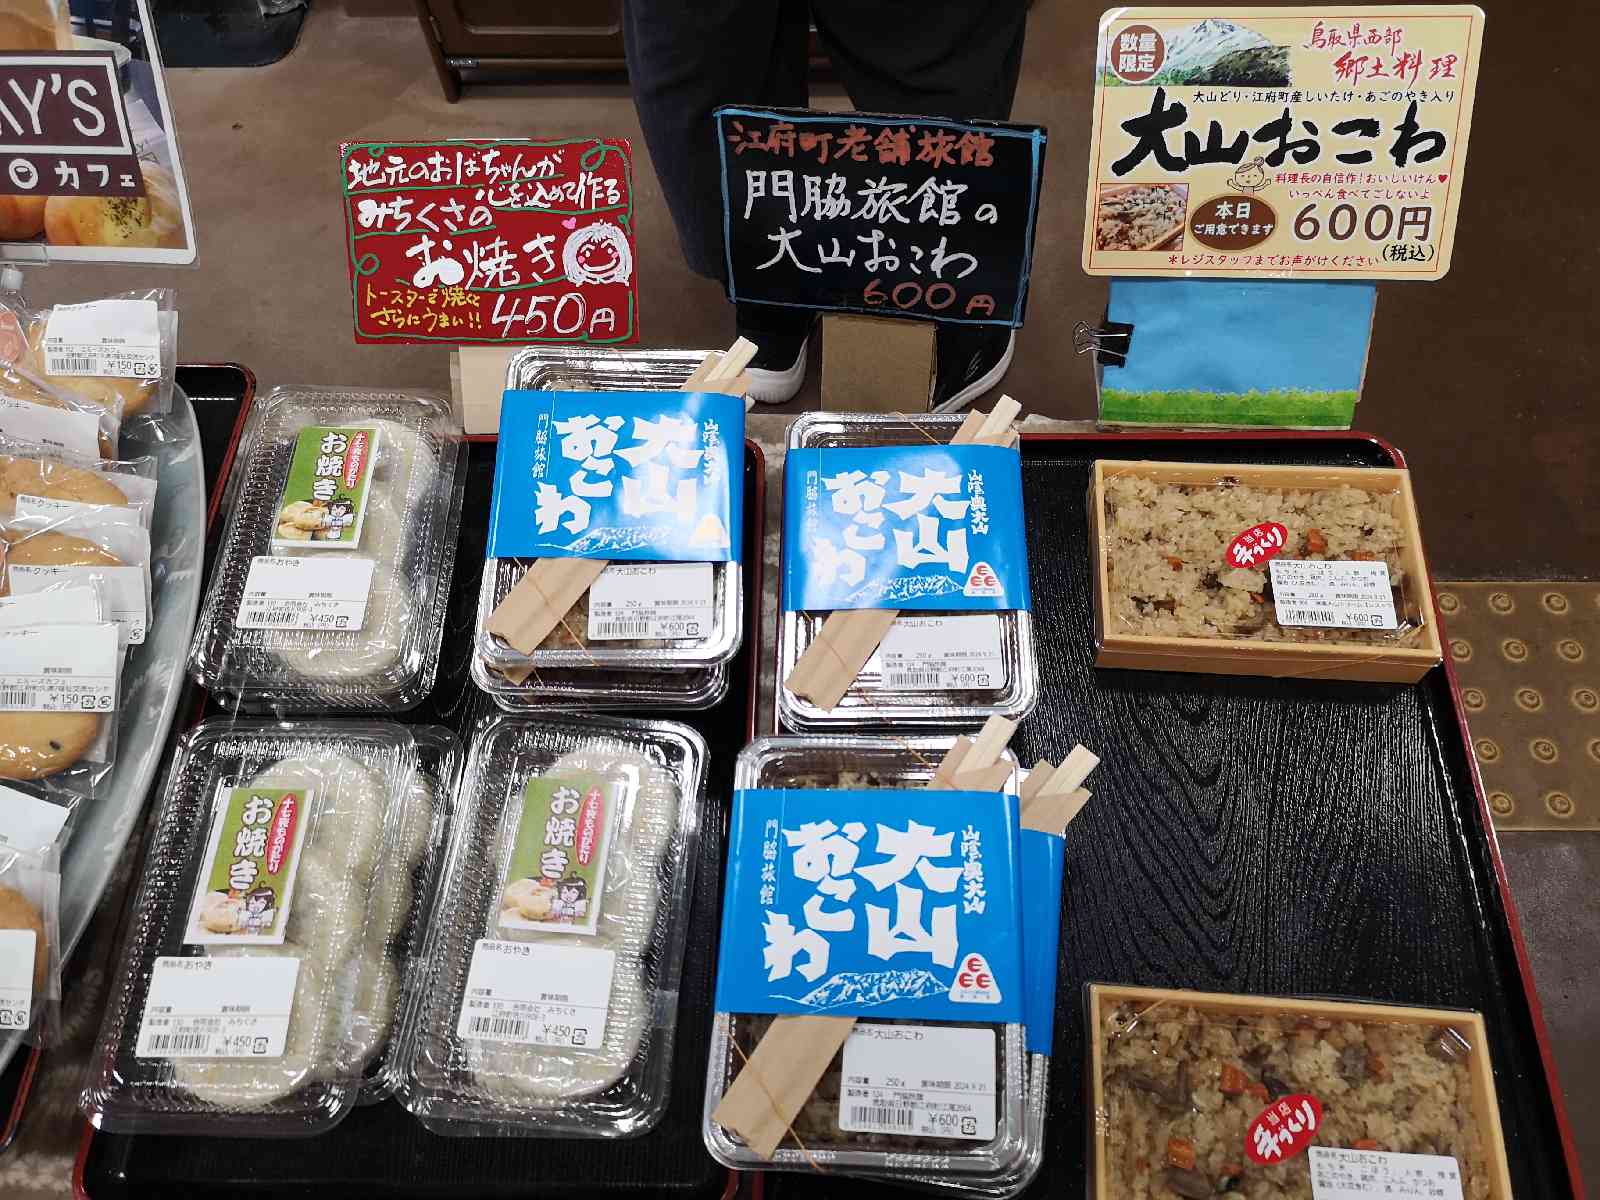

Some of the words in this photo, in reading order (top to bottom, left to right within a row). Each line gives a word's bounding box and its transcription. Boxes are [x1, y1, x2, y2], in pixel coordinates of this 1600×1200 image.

[1120, 33, 1157, 52] 数量
[1303, 21, 1402, 56] 鳥取県西部
[1119, 53, 1155, 72] 限定
[1333, 50, 1458, 89] 郷土料理
[727, 121, 996, 168] 江府町老舗旅館
[1111, 86, 1447, 177] 大山おこわ
[54, 160, 136, 190] カフェ
[347, 148, 566, 190] 地元のおばちゃんが
[475, 170, 621, 210] 心を込めて作る
[357, 196, 493, 232] みちくさの
[743, 169, 998, 226] 門脇旅館の
[1215, 201, 1251, 219] 本日
[1289, 189, 1430, 201] いっぺん食べてごしないよ
[1194, 223, 1274, 236] ご用意できます
[1294, 203, 1432, 242] 600円
[405, 233, 558, 290] お焼き
[755, 226, 979, 278] 大山おこわ
[366, 284, 481, 308] トースターで焼くと
[491, 292, 616, 337] 450円
[863, 279, 997, 317] 600円
[313, 432, 349, 500] お焼き
[534, 414, 626, 535] おこわ
[813, 469, 891, 587] おこわ
[882, 467, 970, 573] 大山
[228, 794, 274, 890] お焼き
[540, 785, 582, 880] お焼き
[759, 819, 779, 905] 門脇旅館
[761, 819, 868, 983] おこわ
[854, 819, 965, 969] 大山
[929, 1112, 958, 1127] ¥600
